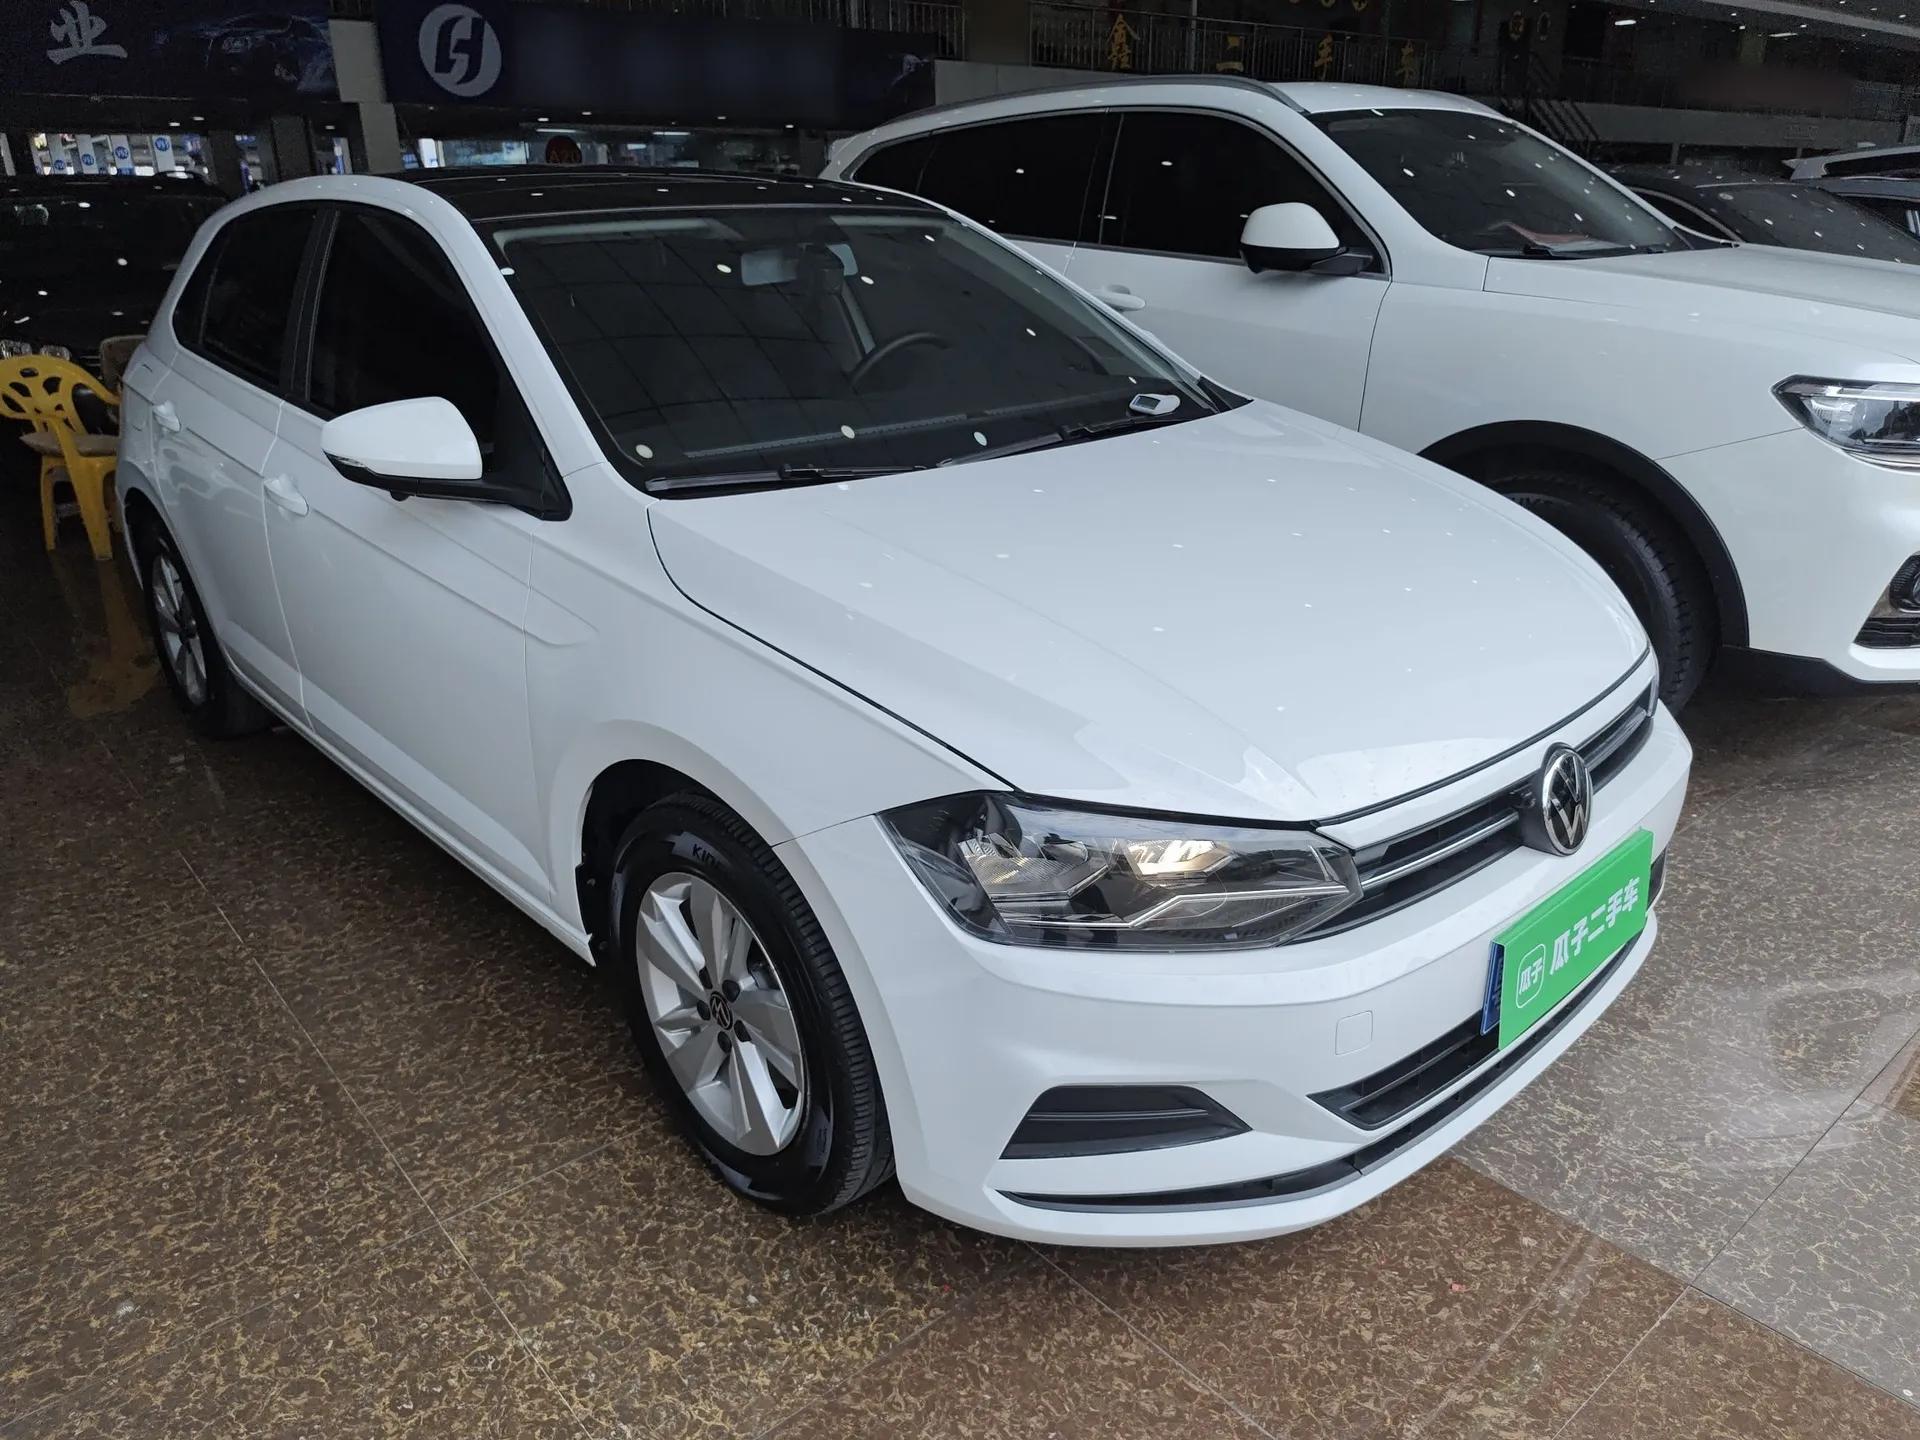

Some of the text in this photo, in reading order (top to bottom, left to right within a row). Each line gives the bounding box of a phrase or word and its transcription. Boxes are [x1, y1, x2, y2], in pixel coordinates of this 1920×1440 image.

[47, 0, 128, 65] 业
[1549, 876, 1640, 976] 瓜子二手车
[1519, 957, 1543, 995] 瓜子
